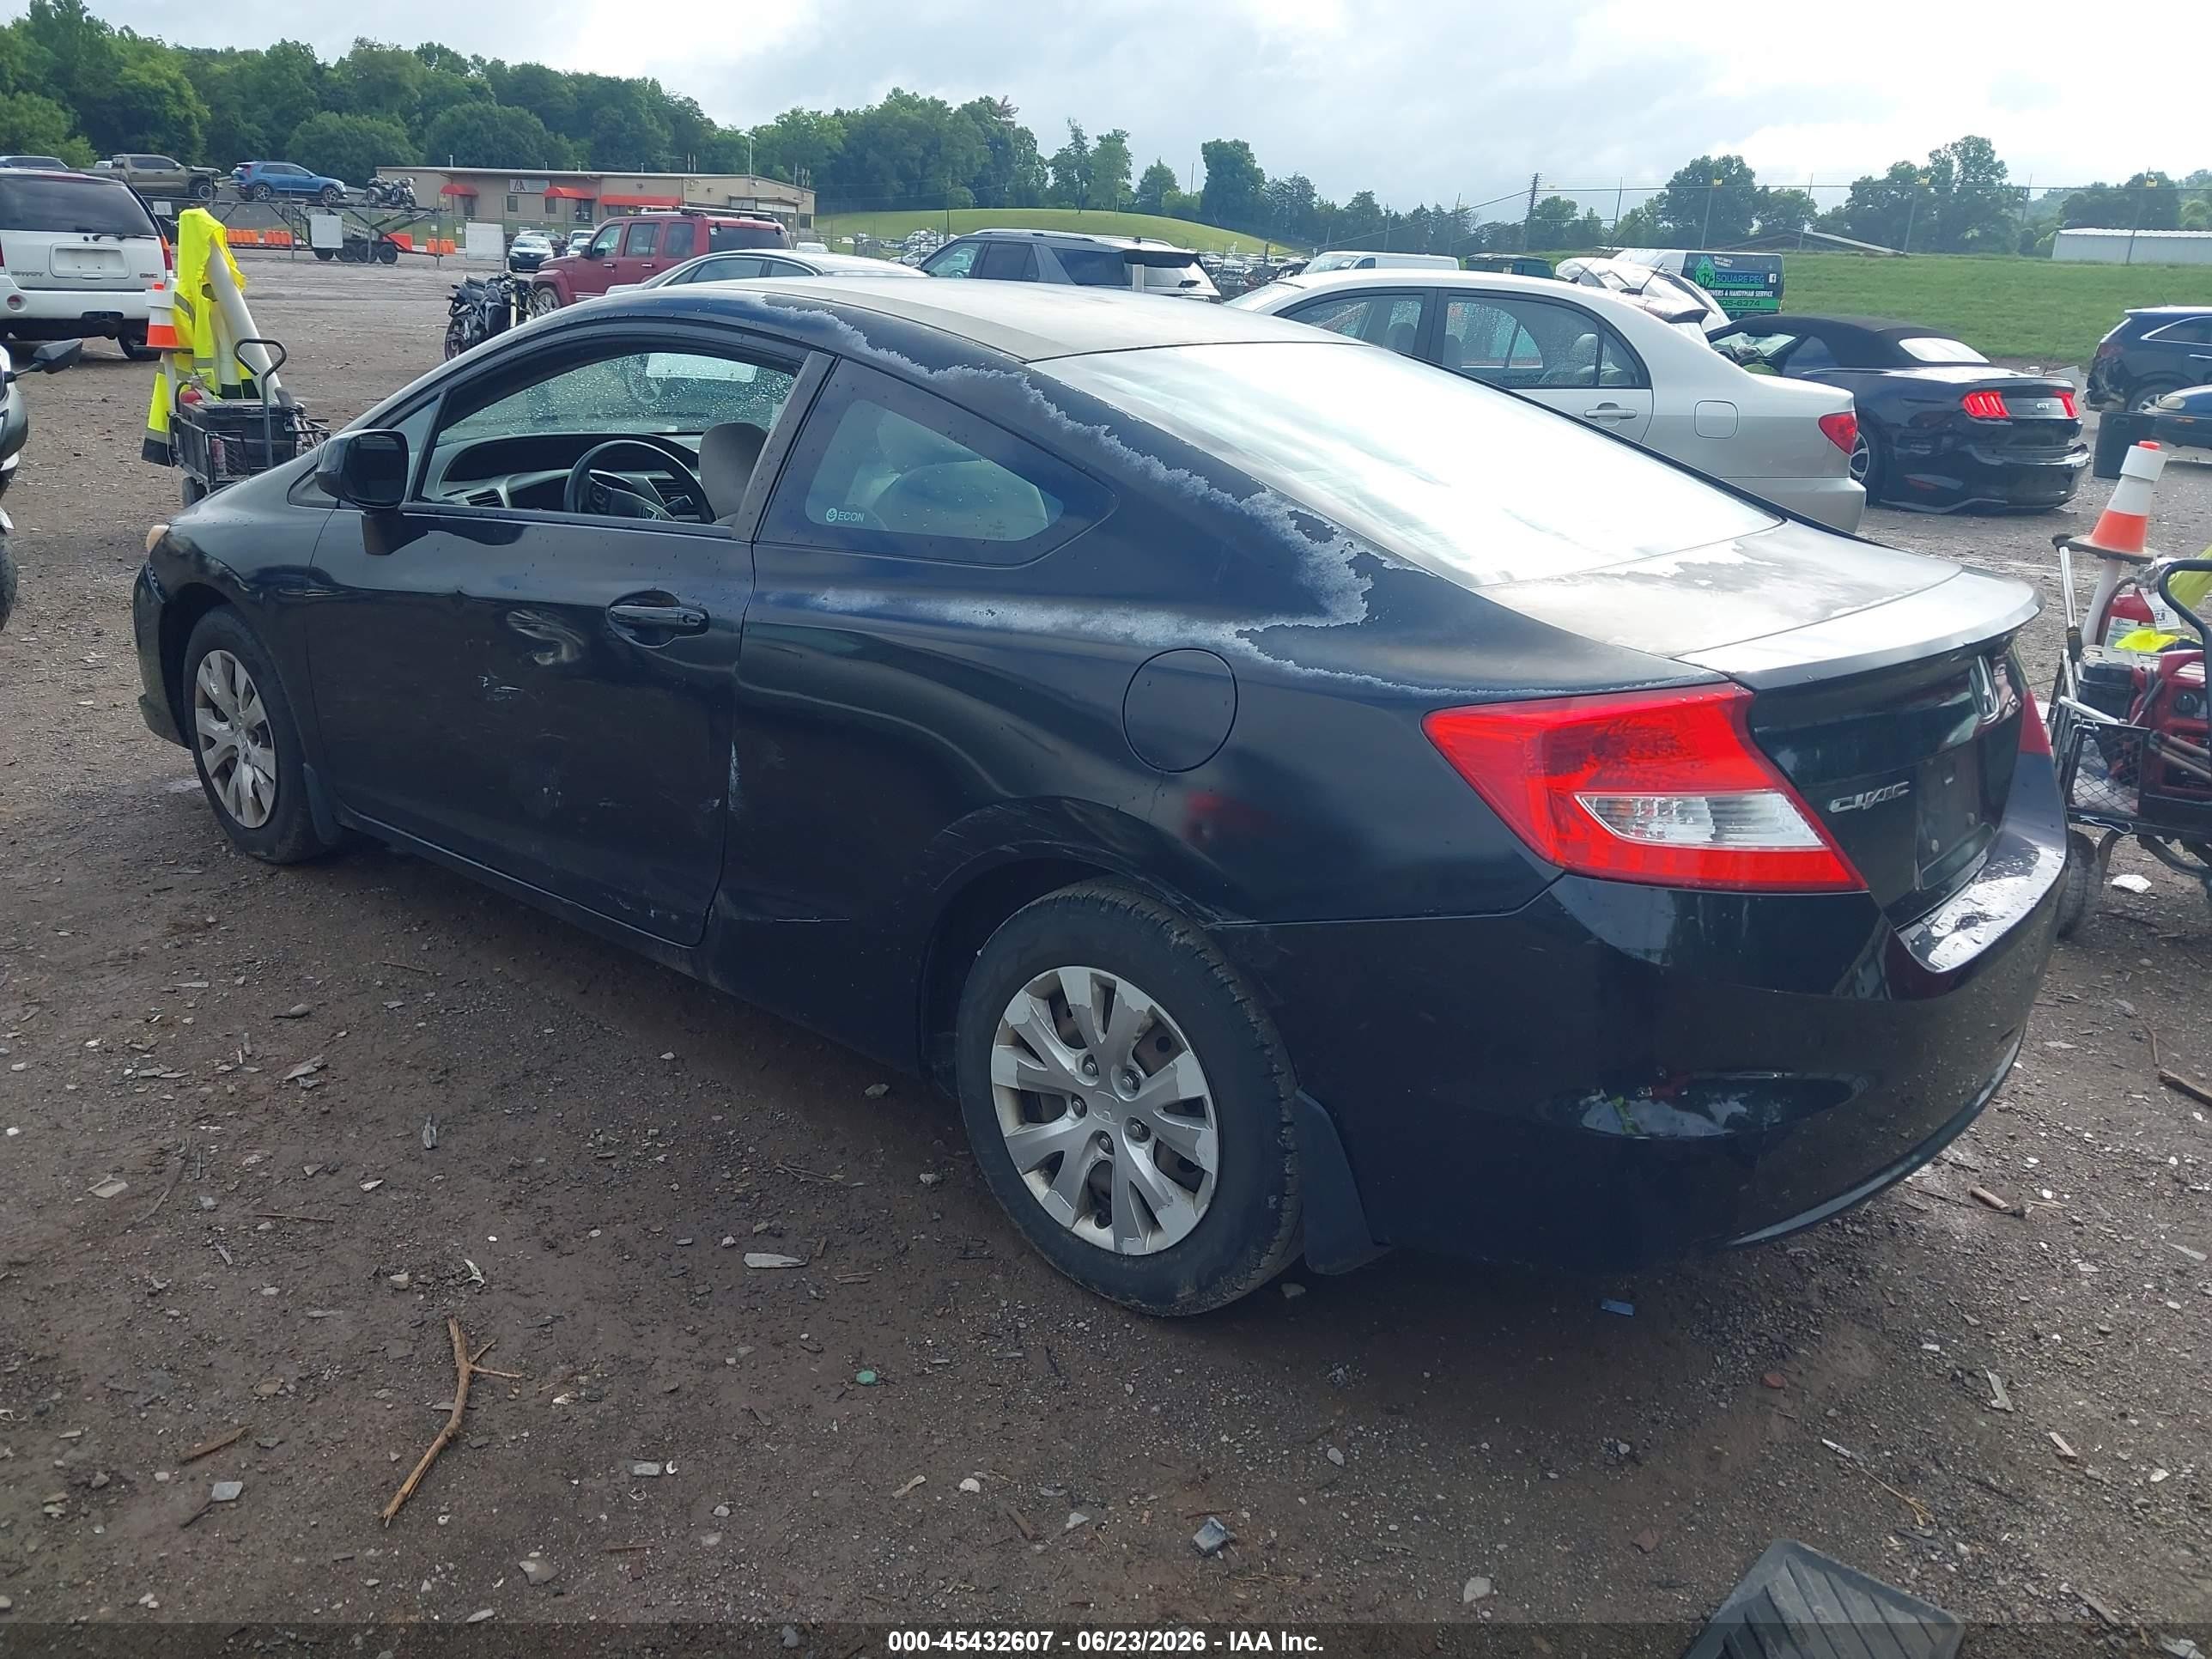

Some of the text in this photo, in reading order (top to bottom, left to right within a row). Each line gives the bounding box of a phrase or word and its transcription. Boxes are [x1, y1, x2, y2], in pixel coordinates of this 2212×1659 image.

[1716, 274, 1765, 283] SQUARE PEG
[837, 511, 866, 523] ECON
[1828, 781, 1911, 814] CIVIC
